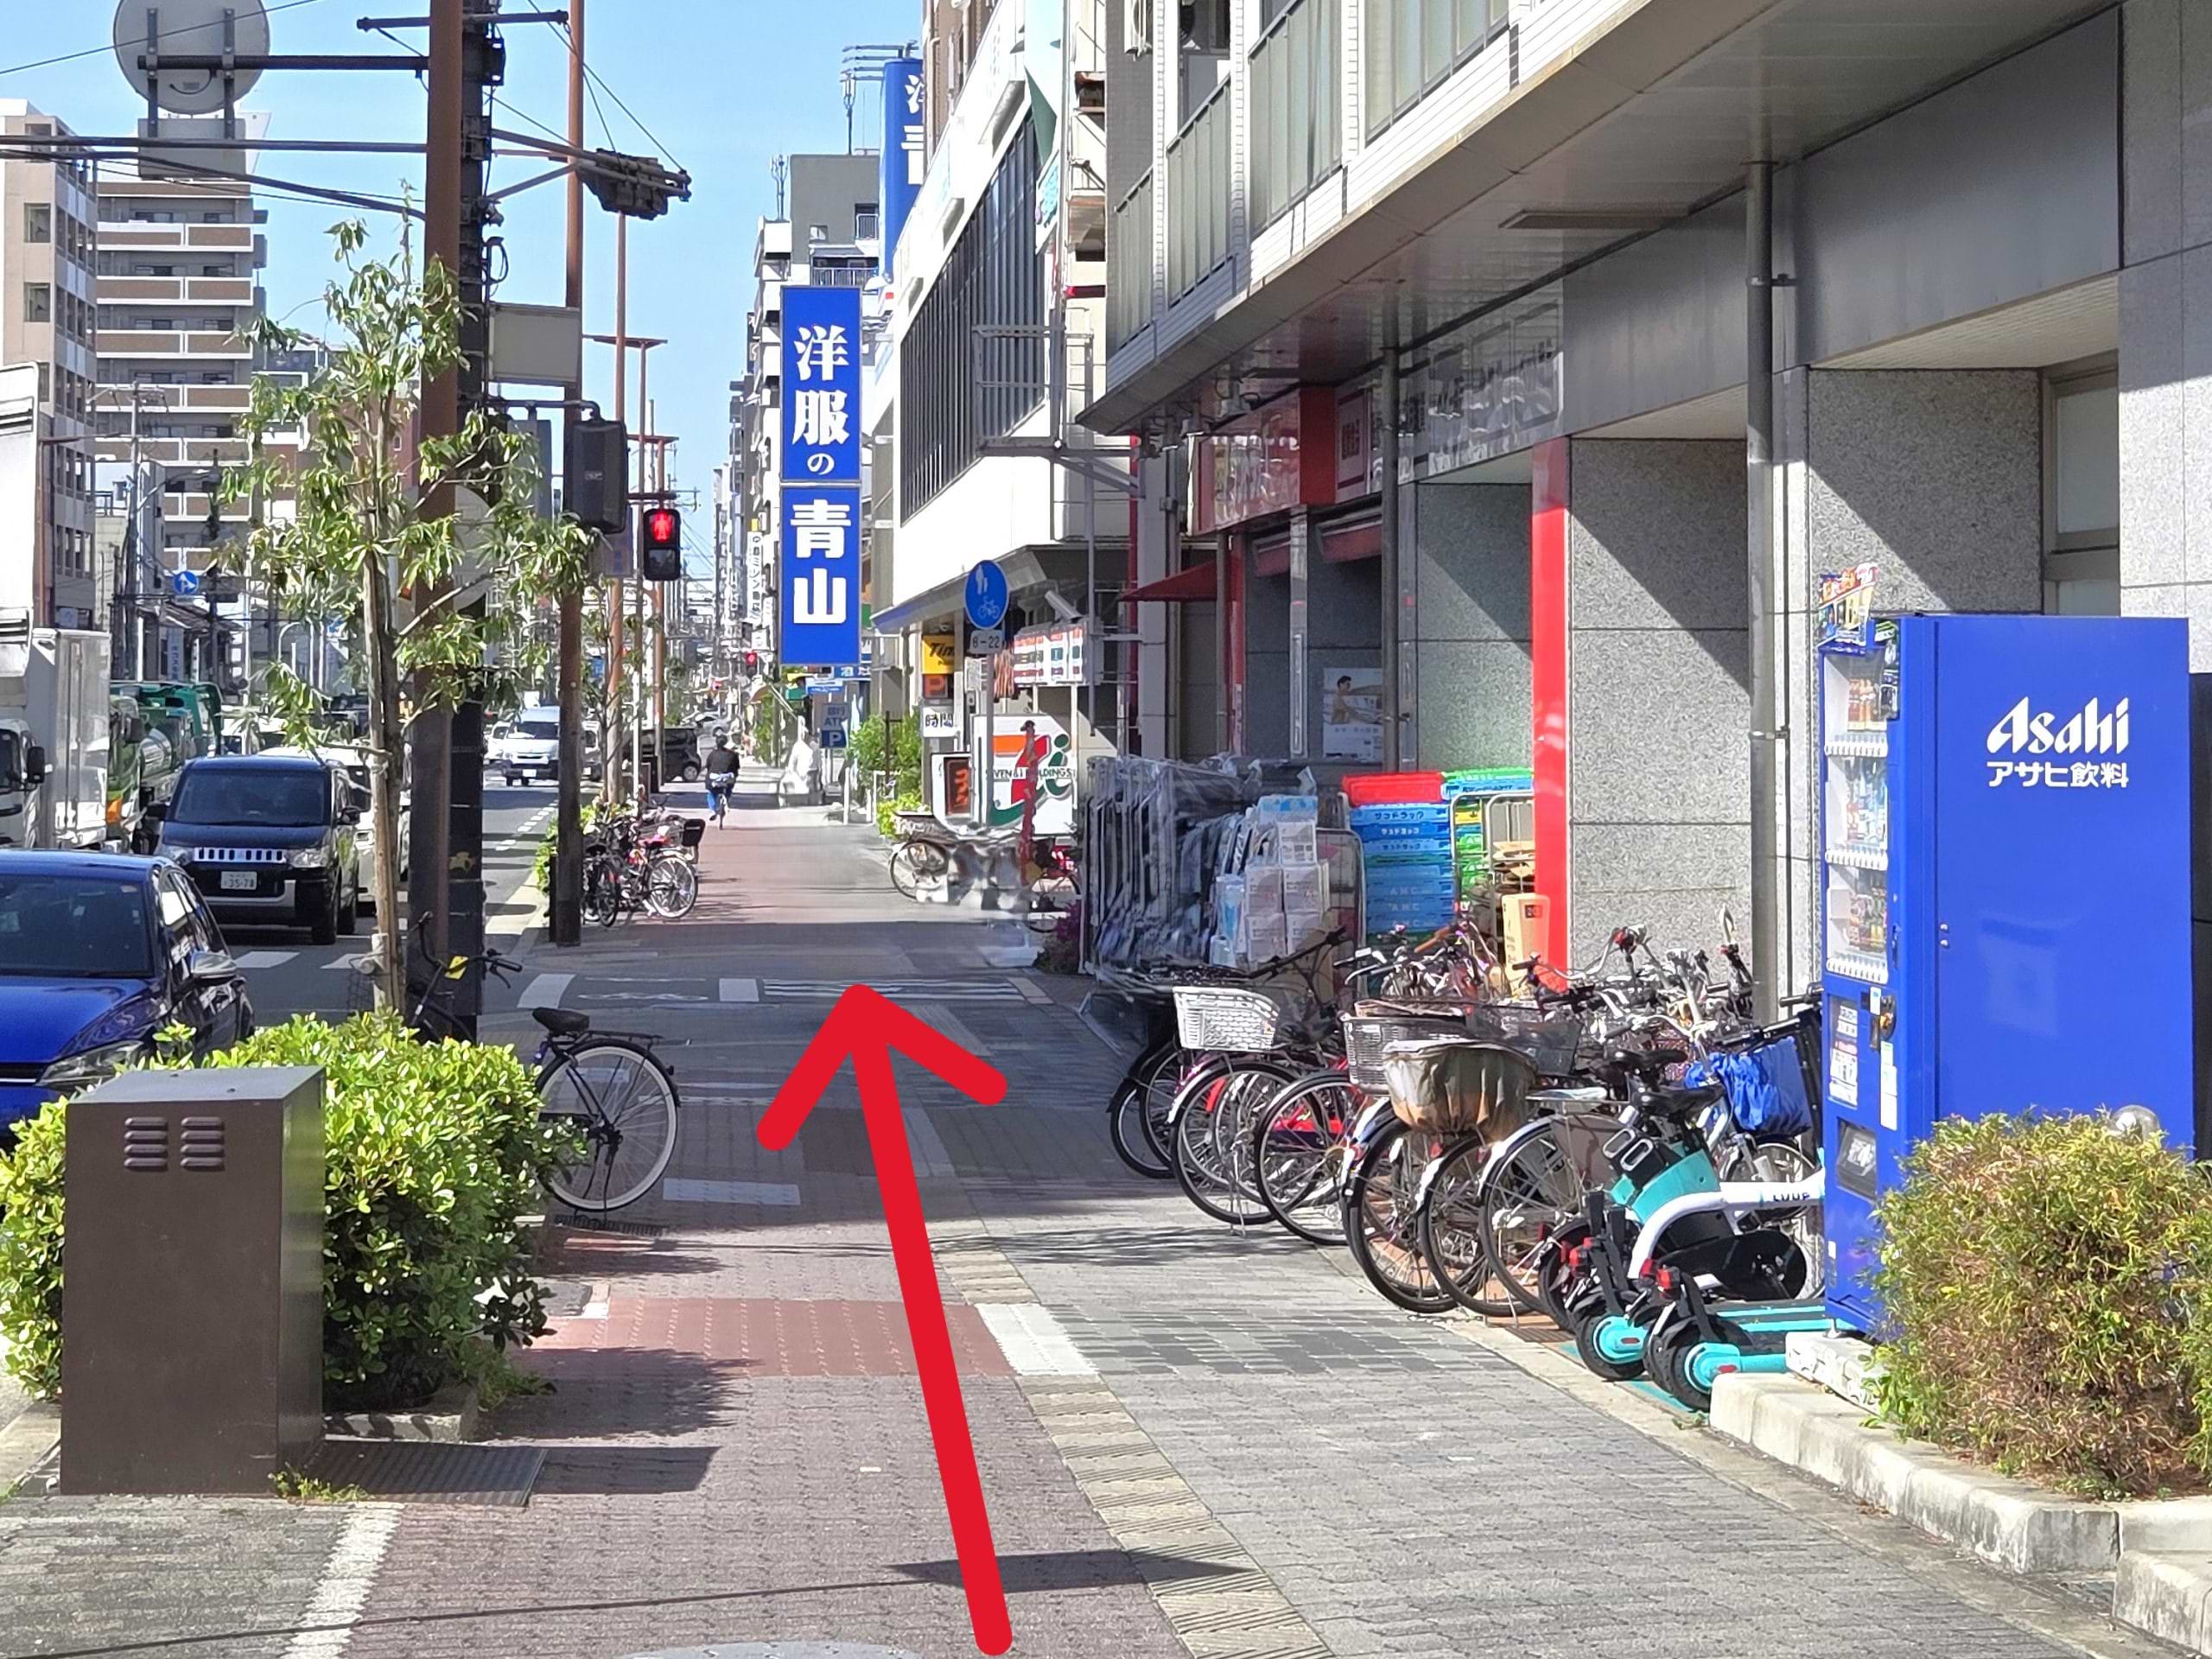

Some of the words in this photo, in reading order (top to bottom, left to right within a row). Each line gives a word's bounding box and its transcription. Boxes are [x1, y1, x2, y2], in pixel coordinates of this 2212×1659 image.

[790, 325, 852, 625] 洋服の青山
[829, 732, 842, 747] P
[1986, 696, 2130, 755] Asahi
[1986, 761, 2129, 789] アサヒ飲料
[1773, 1192, 1811, 1202] LUUP
